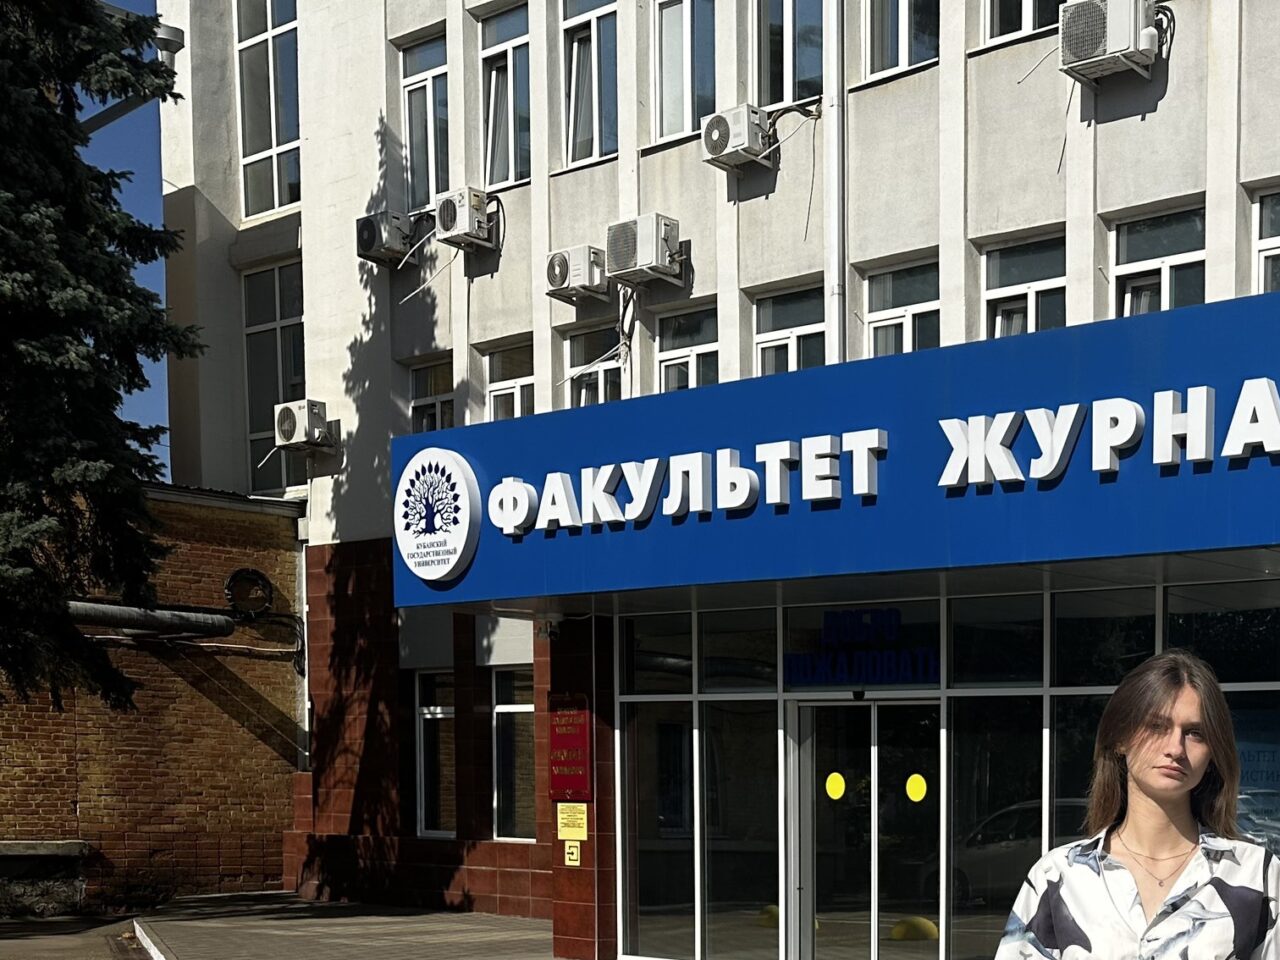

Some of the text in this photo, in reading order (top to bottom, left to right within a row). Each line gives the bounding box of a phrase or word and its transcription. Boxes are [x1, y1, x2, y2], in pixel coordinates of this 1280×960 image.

[487, 428, 888, 537] ФАКУЛЬТЕТ
[416, 539, 447, 550] КУБАНСКИЙ
[407, 547, 457, 560] ГОСУДАРСТВЕННЫЙ
[414, 558, 450, 568] УНИВЕРСИТЕТ
